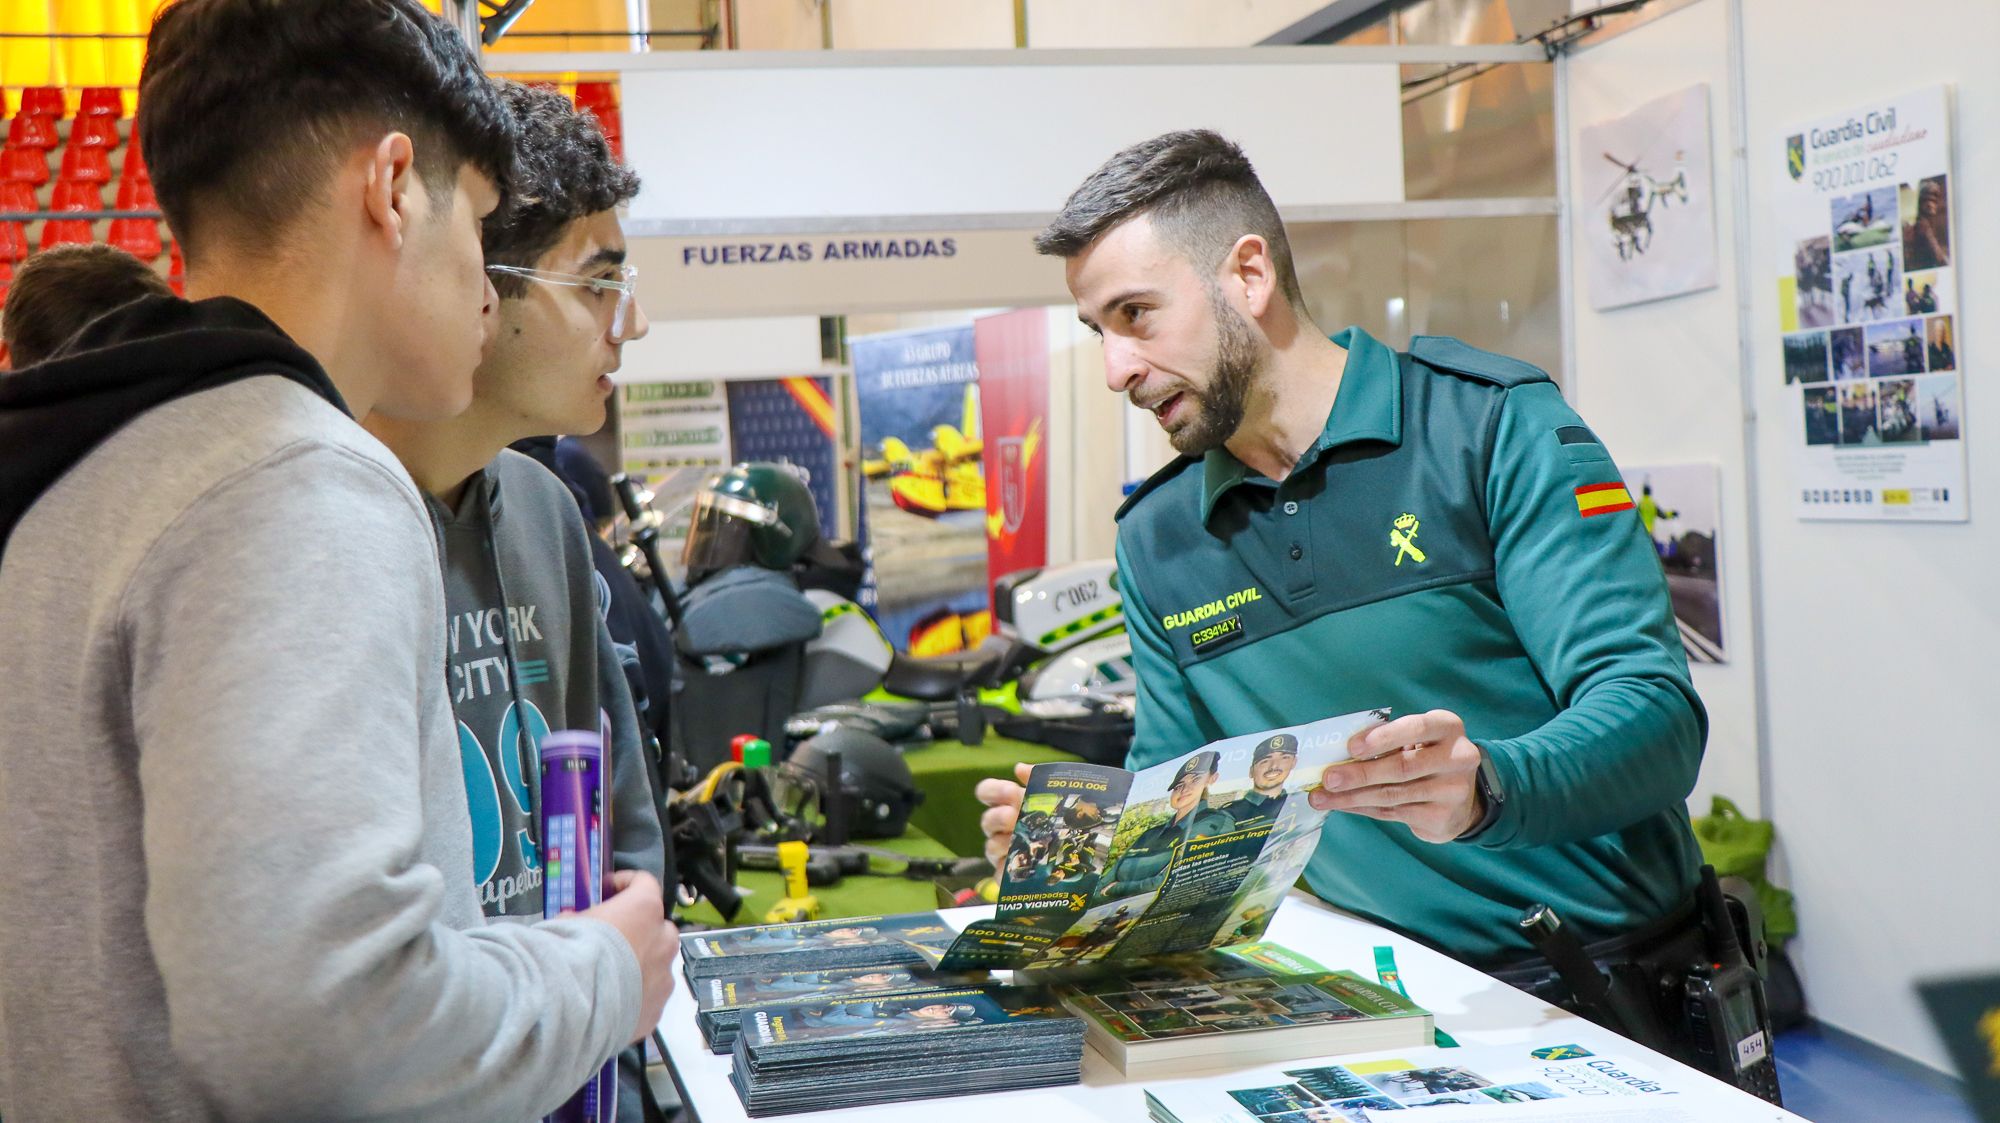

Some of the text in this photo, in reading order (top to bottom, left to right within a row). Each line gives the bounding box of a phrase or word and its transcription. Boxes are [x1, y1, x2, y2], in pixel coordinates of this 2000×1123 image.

[1810, 107, 1896, 149] Guardia Civil
[1813, 166, 1841, 192] 900
[1868, 152, 1898, 181] 062
[683, 238, 957, 265] FUERZAS ARMADAS
[917, 341, 951, 362] GRUPO
[894, 366, 939, 387] FUERZAS
[1068, 580, 1102, 606] 062
[1163, 587, 1262, 630] GUARDIA CIVIL
[465, 605, 543, 648] YORK
[1192, 619, 1236, 645] C33414Y
[1047, 780, 1108, 791] 900 101 062
[1189, 834, 1246, 852] Requisitos
[998, 899, 1070, 912] GUARDIA CIVIL
[1001, 892, 1070, 902] Especialidades
[965, 928, 1052, 944] 900 101 062
[1743, 1039, 1762, 1054] 454
[1586, 1060, 1662, 1093] Guardia
